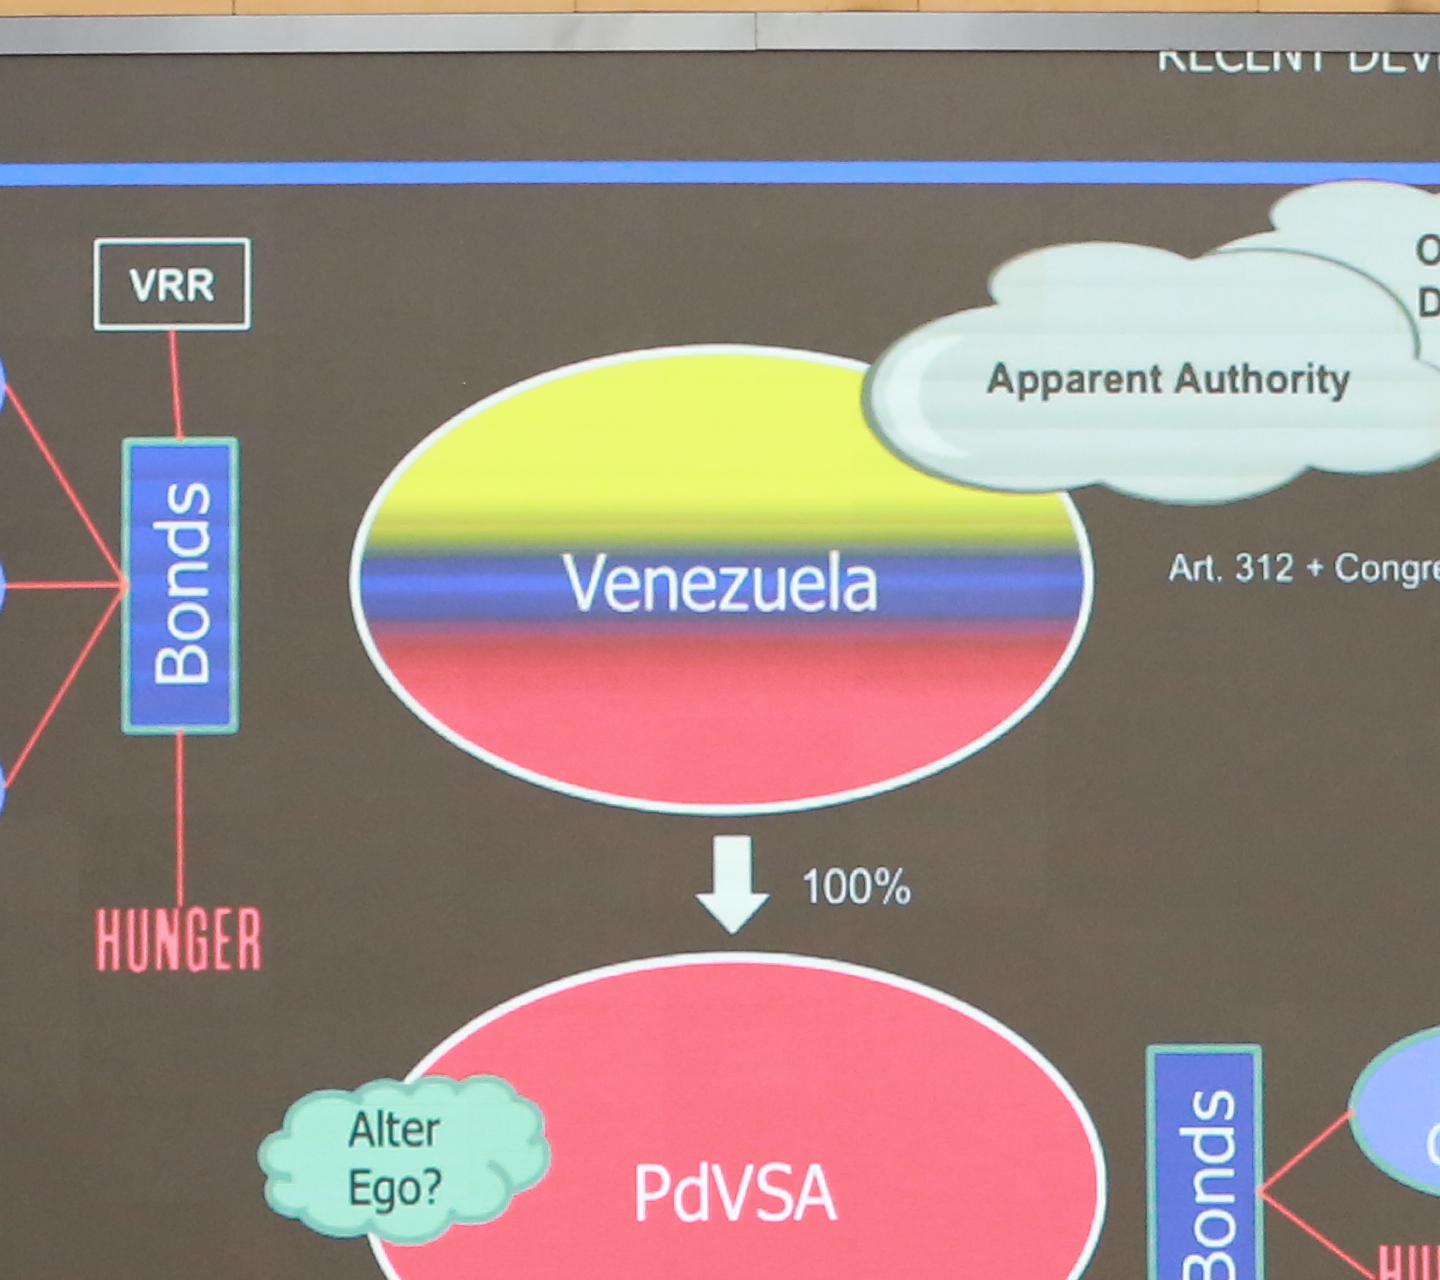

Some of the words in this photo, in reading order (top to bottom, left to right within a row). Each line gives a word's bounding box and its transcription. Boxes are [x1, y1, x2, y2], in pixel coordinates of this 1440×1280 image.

[130, 269, 215, 303] VRR
[988, 362, 1164, 403] Apparent
[1175, 362, 1352, 404] Authority
[153, 483, 212, 685] Bonds
[562, 550, 880, 613] Venezuela
[1170, 554, 1221, 583] Art.
[1236, 553, 1295, 584] 312
[1307, 559, 1325, 578] +
[804, 868, 912, 906] 100%
[98, 908, 261, 973] HUNGER
[349, 1110, 442, 1149] Alter
[350, 1168, 443, 1216] Ego?
[637, 1162, 840, 1224] PdVSA
